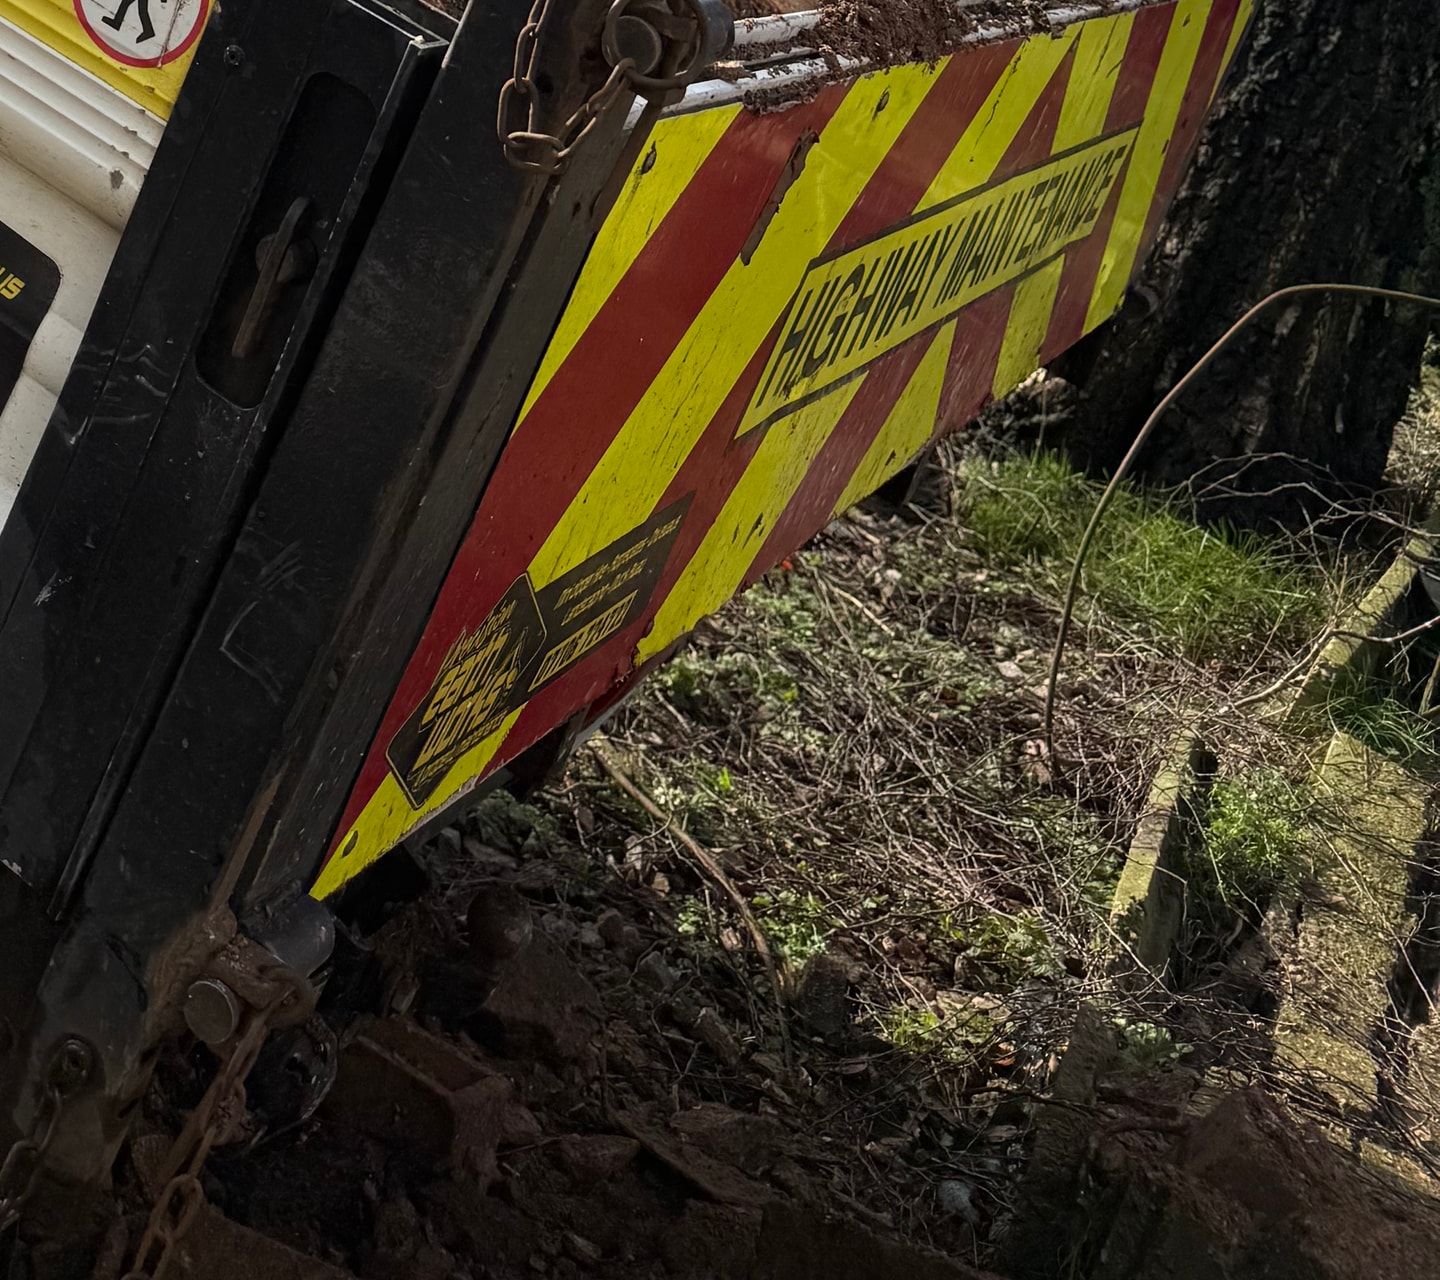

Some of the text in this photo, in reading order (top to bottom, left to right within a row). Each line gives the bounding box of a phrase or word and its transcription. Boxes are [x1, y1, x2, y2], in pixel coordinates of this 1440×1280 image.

[755, 144, 1128, 409] HIGHWAY MAINTENANCE
[412, 667, 508, 771] works
[421, 628, 509, 726] earth
